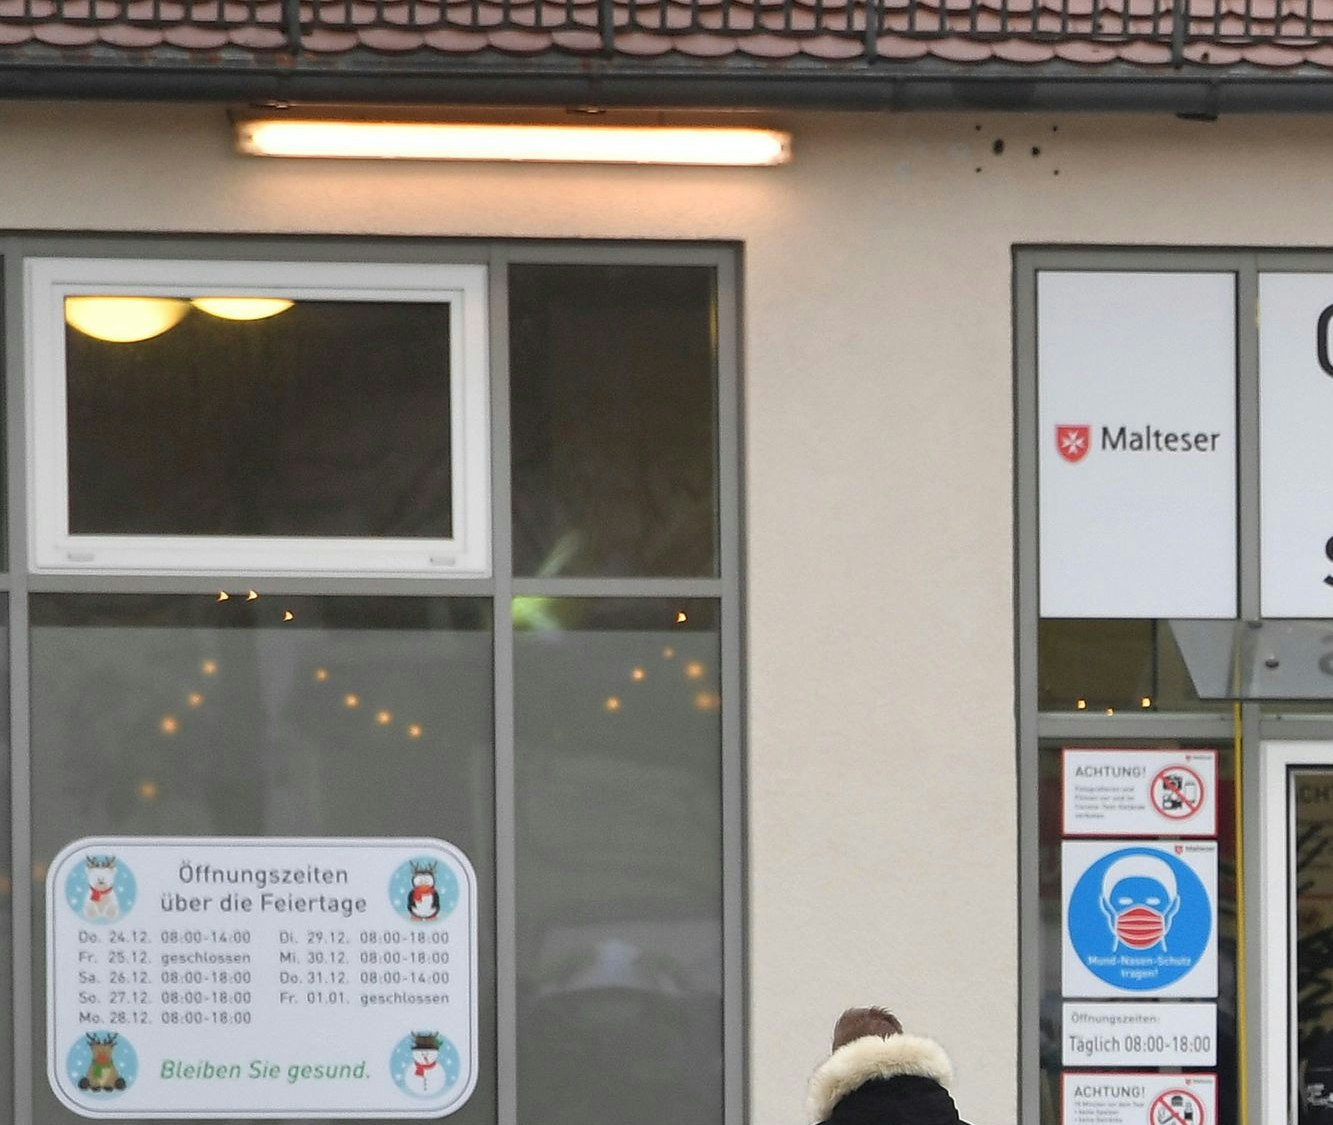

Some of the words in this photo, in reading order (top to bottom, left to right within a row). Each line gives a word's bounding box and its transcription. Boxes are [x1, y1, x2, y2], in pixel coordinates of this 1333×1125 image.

[1101, 424, 1221, 454] Malteser
[1074, 765, 1147, 779] ACHTUNG!
[178, 859, 349, 885] Öffnungszeiten
[160, 892, 213, 913] über
[219, 892, 253, 913] die
[260, 892, 367, 918] Feiertage
[78, 930, 101, 944] Do.
[109, 930, 152, 944] 24.12.
[161, 930, 251, 944] 08:00-14:00
[279, 930, 298, 944] Di.
[307, 930, 350, 944] 29.12.
[360, 930, 450, 944] 08:00-18:00
[78, 950, 97, 964] Fr.
[109, 950, 152, 964] 25.12.
[161, 950, 251, 967] geschlossen
[279, 950, 300, 964] Mi.
[307, 950, 350, 964] 30.12.
[360, 950, 450, 964] 08:00-18:00
[1087, 955, 1192, 967] Mund-Nasen-Schutz
[78, 970, 100, 984] Sa.
[109, 970, 152, 984] 26.12.
[161, 970, 251, 984] 08:00-18:00
[279, 970, 302, 984] Do.
[307, 970, 350, 984] 31.12.
[360, 970, 450, 984] 08:00-14:00
[1121, 968, 1159, 980] tragen!
[78, 990, 100, 1005] So.
[109, 990, 152, 1005] 27.12.
[161, 990, 251, 1005] 08:00-18:00
[279, 990, 298, 1005] Fr.
[307, 990, 350, 1005] 01.01.
[360, 990, 450, 1008] geschlossen
[78, 1010, 104, 1025] Mo.
[109, 1010, 152, 1025] 28.12.
[161, 1010, 251, 1025] 08:00-18:00
[1071, 1011, 1161, 1025] Öffnungszeiten:
[1069, 1035, 1120, 1057] Täglich
[1124, 1035, 1211, 1053] 08:00-18:00
[160, 1059, 242, 1080] Bleiben
[248, 1059, 281, 1080] Sie
[287, 1059, 370, 1085] gesund.
[1073, 1085, 1146, 1099] ACHTUNG!
